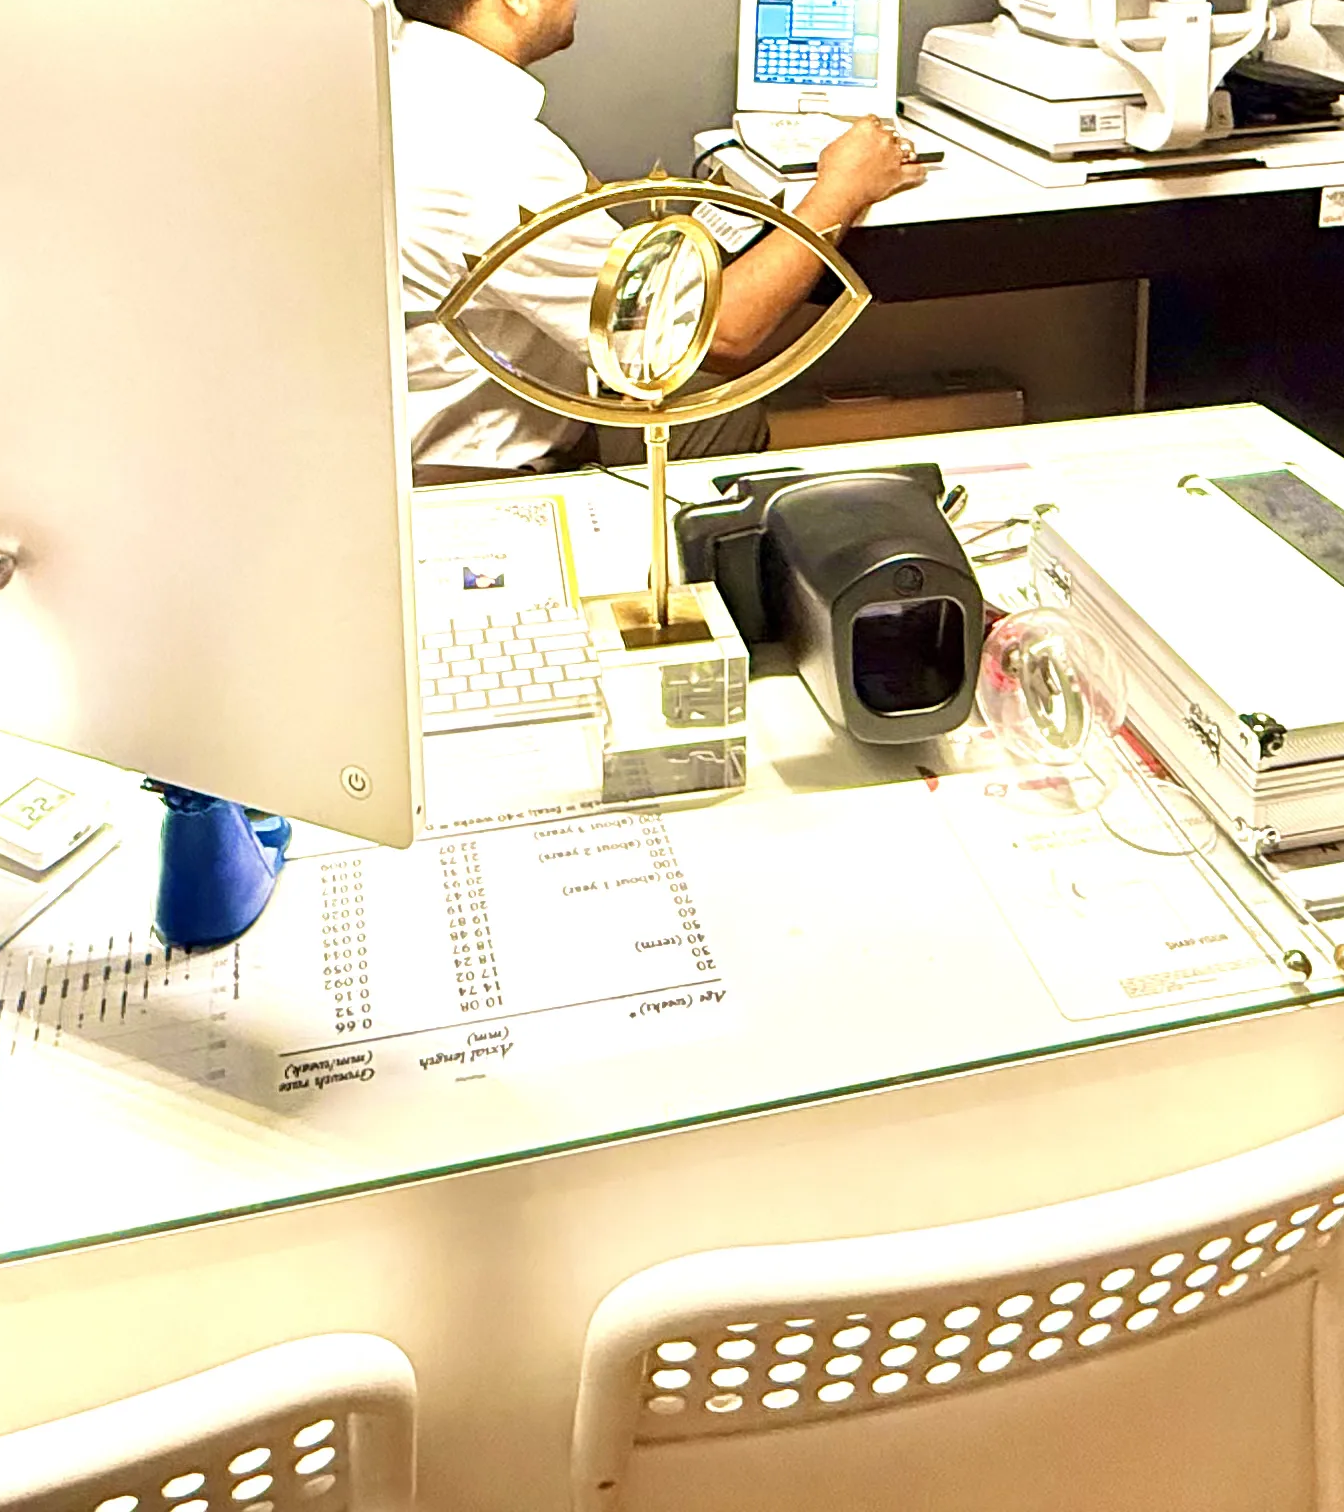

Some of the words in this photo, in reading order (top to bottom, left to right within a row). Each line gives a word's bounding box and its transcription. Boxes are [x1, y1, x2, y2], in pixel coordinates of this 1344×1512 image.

[591, 816, 634, 830] (about
[534, 825, 574, 840] years)
[642, 825, 667, 835] 170
[597, 839, 641, 853] (about
[646, 836, 671, 847] 140
[538, 847, 579, 863] years)
[650, 847, 674, 858] 120
[653, 859, 678, 869] 100
[616, 872, 661, 887] (about
[666, 870, 684, 880] 90
[562, 881, 598, 896] year)
[670, 882, 688, 892] 80
[674, 894, 693, 905] 70
[678, 907, 696, 918] 60
[682, 920, 701, 930] 50
[635, 935, 682, 952] (term)
[687, 933, 705, 944] 40
[692, 945, 711, 957] 30
[696, 959, 716, 971] 20
[700, 990, 726, 1003] Age
[467, 1026, 509, 1045] (mm)
[471, 1042, 514, 1062] Axial
[420, 1050, 465, 1071] length
[315, 1067, 375, 1088] Growth
